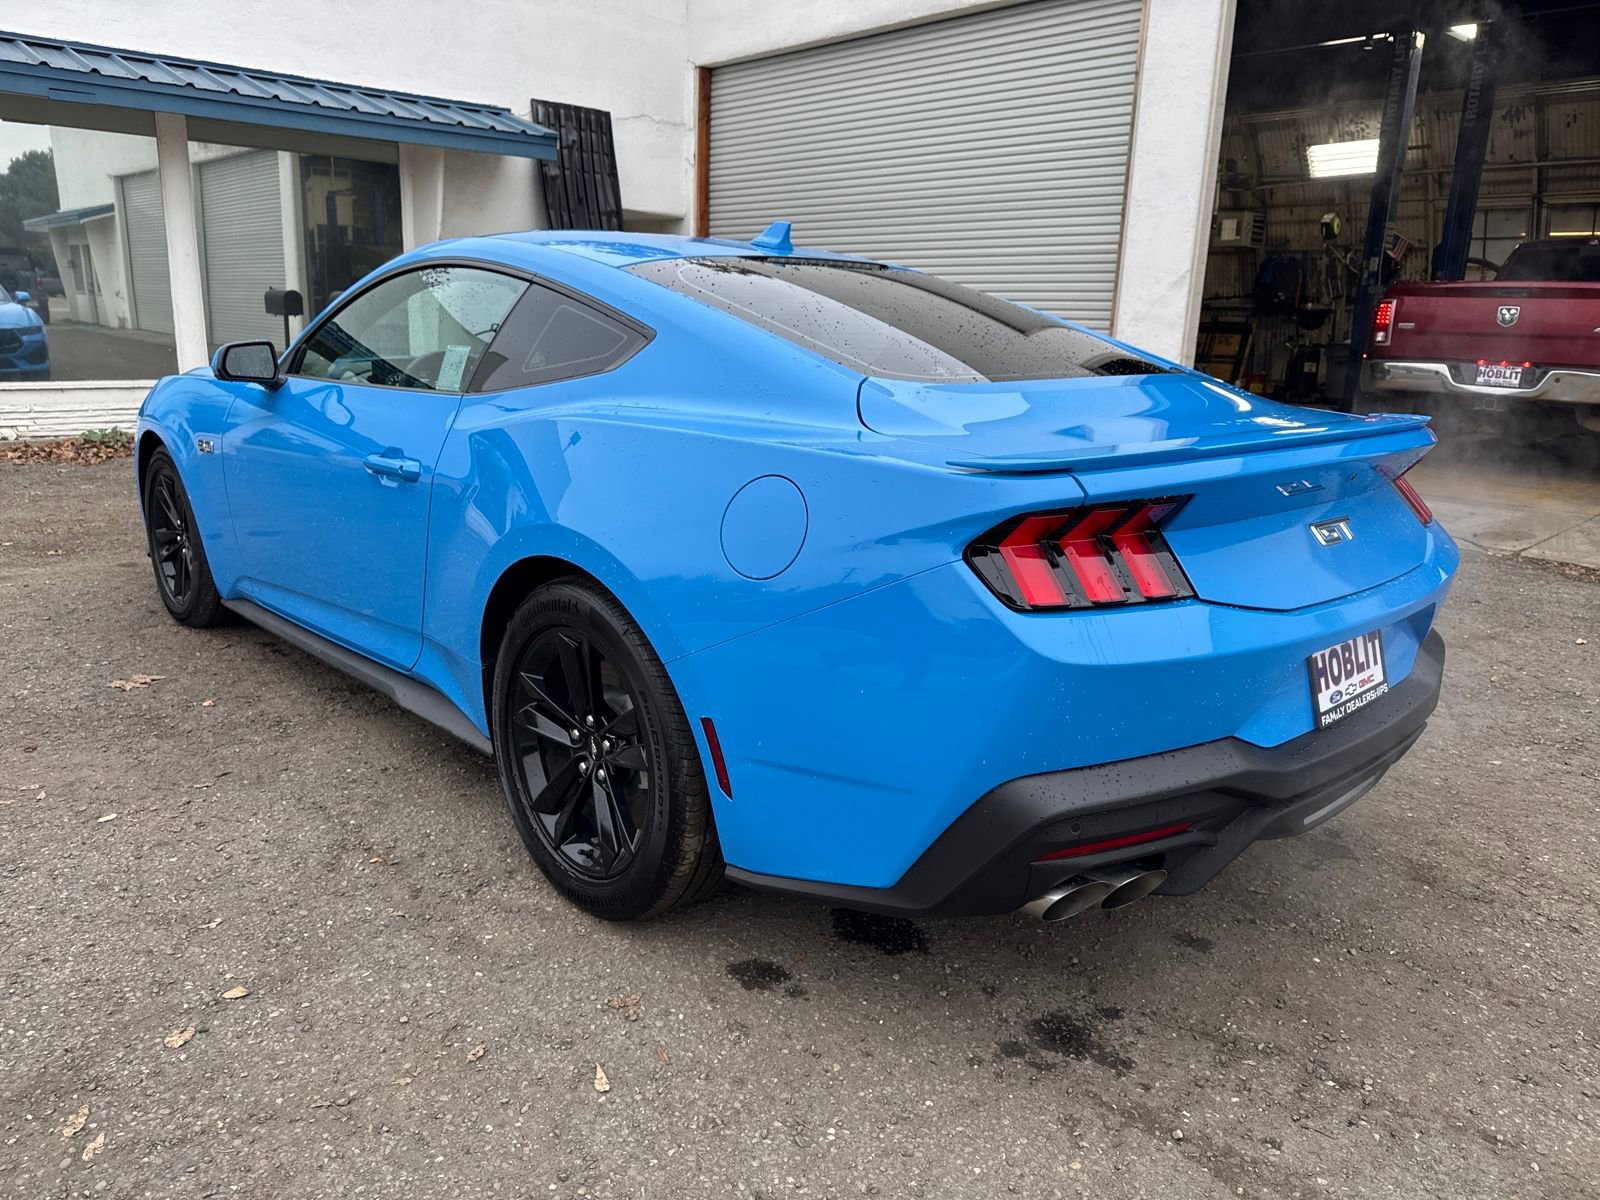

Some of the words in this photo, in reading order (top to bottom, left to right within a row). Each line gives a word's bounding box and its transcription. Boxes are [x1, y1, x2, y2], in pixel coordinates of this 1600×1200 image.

[1393, 33, 1407, 62] LIFT
[1465, 60, 1485, 120] ROTARY
[1479, 368, 1520, 380] HOBLIT
[1310, 516, 1354, 546] GT
[521, 599, 572, 628] Continental
[1312, 631, 1379, 695] HOBLIT
[1359, 673, 1375, 689] GMC
[1346, 683, 1389, 714] DEALERSHIPS
